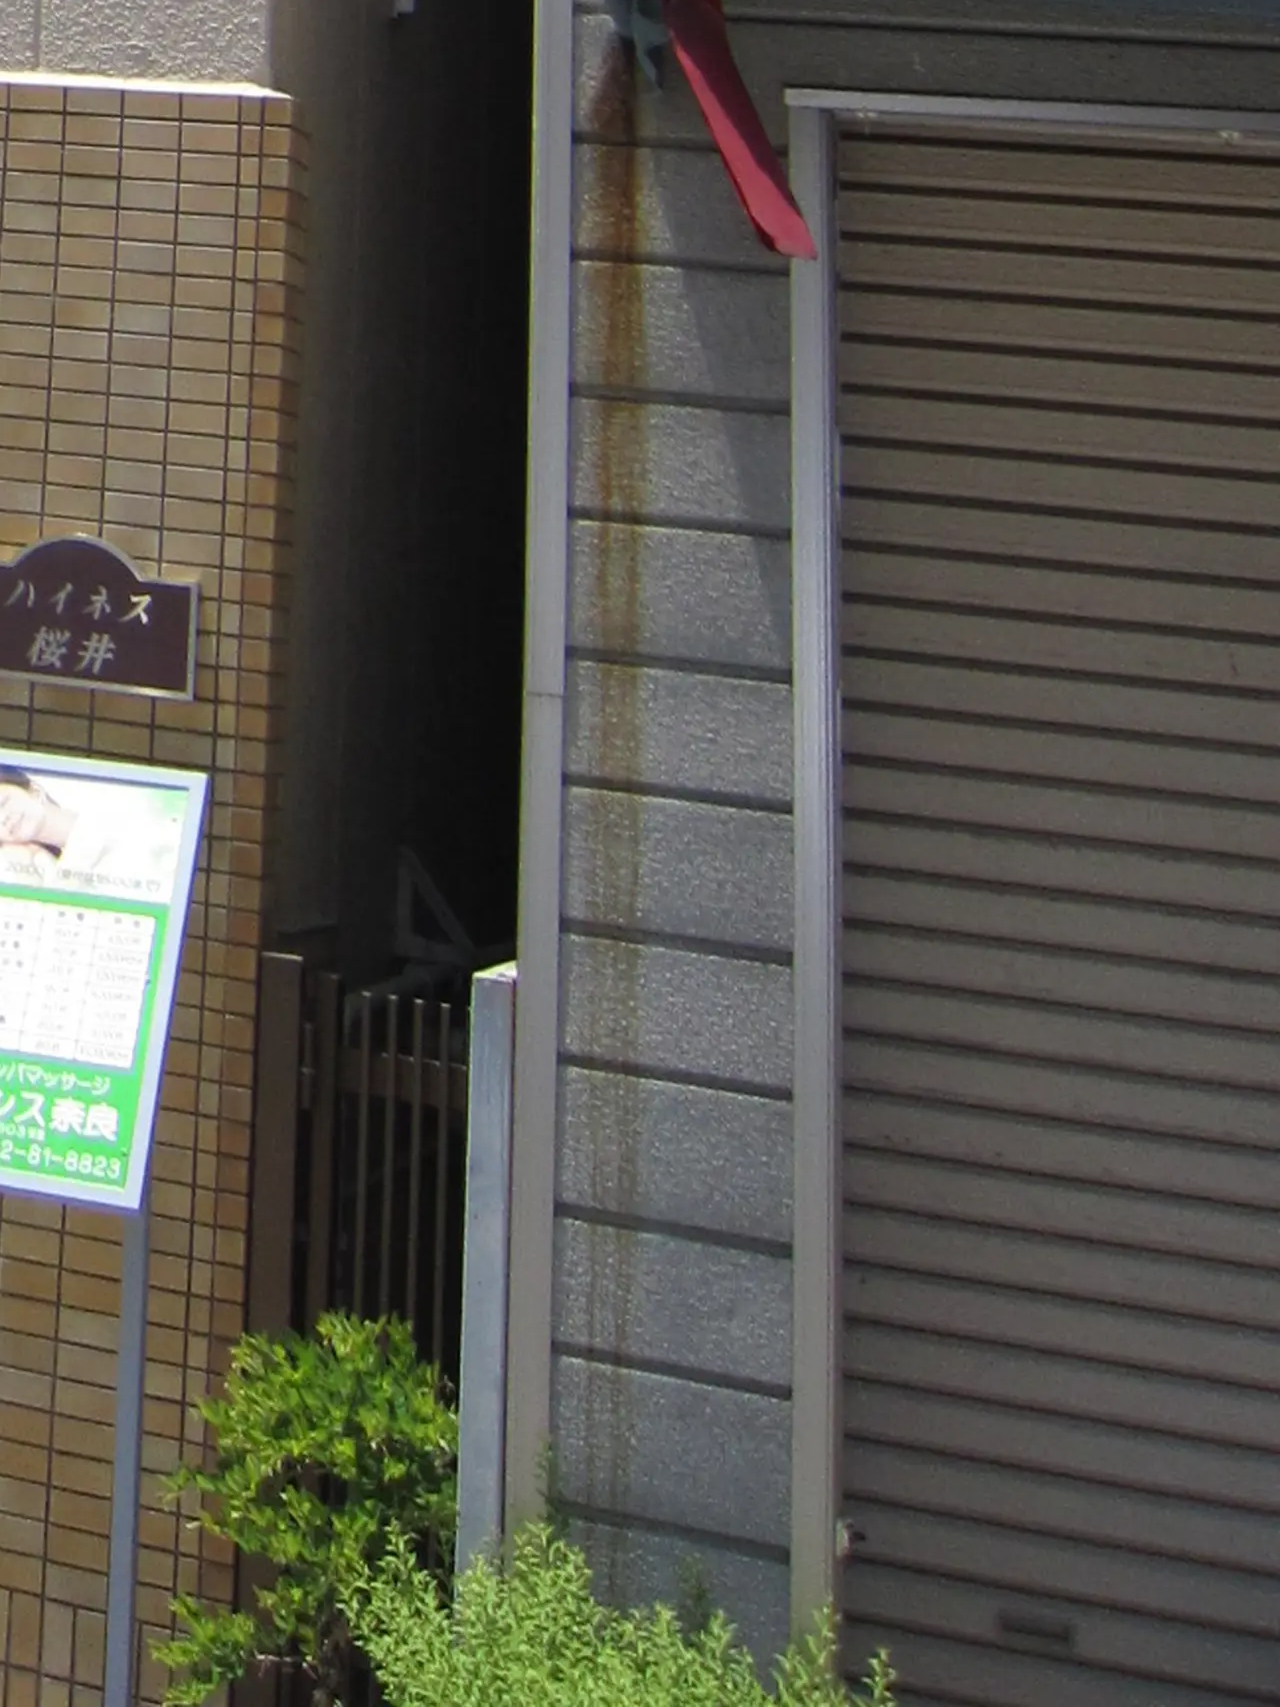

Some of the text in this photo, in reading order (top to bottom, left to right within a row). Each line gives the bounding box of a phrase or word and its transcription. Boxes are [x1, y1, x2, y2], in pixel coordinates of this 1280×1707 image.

[4, 578, 152, 626] ハイネス
[26, 625, 116, 676] 桜井
